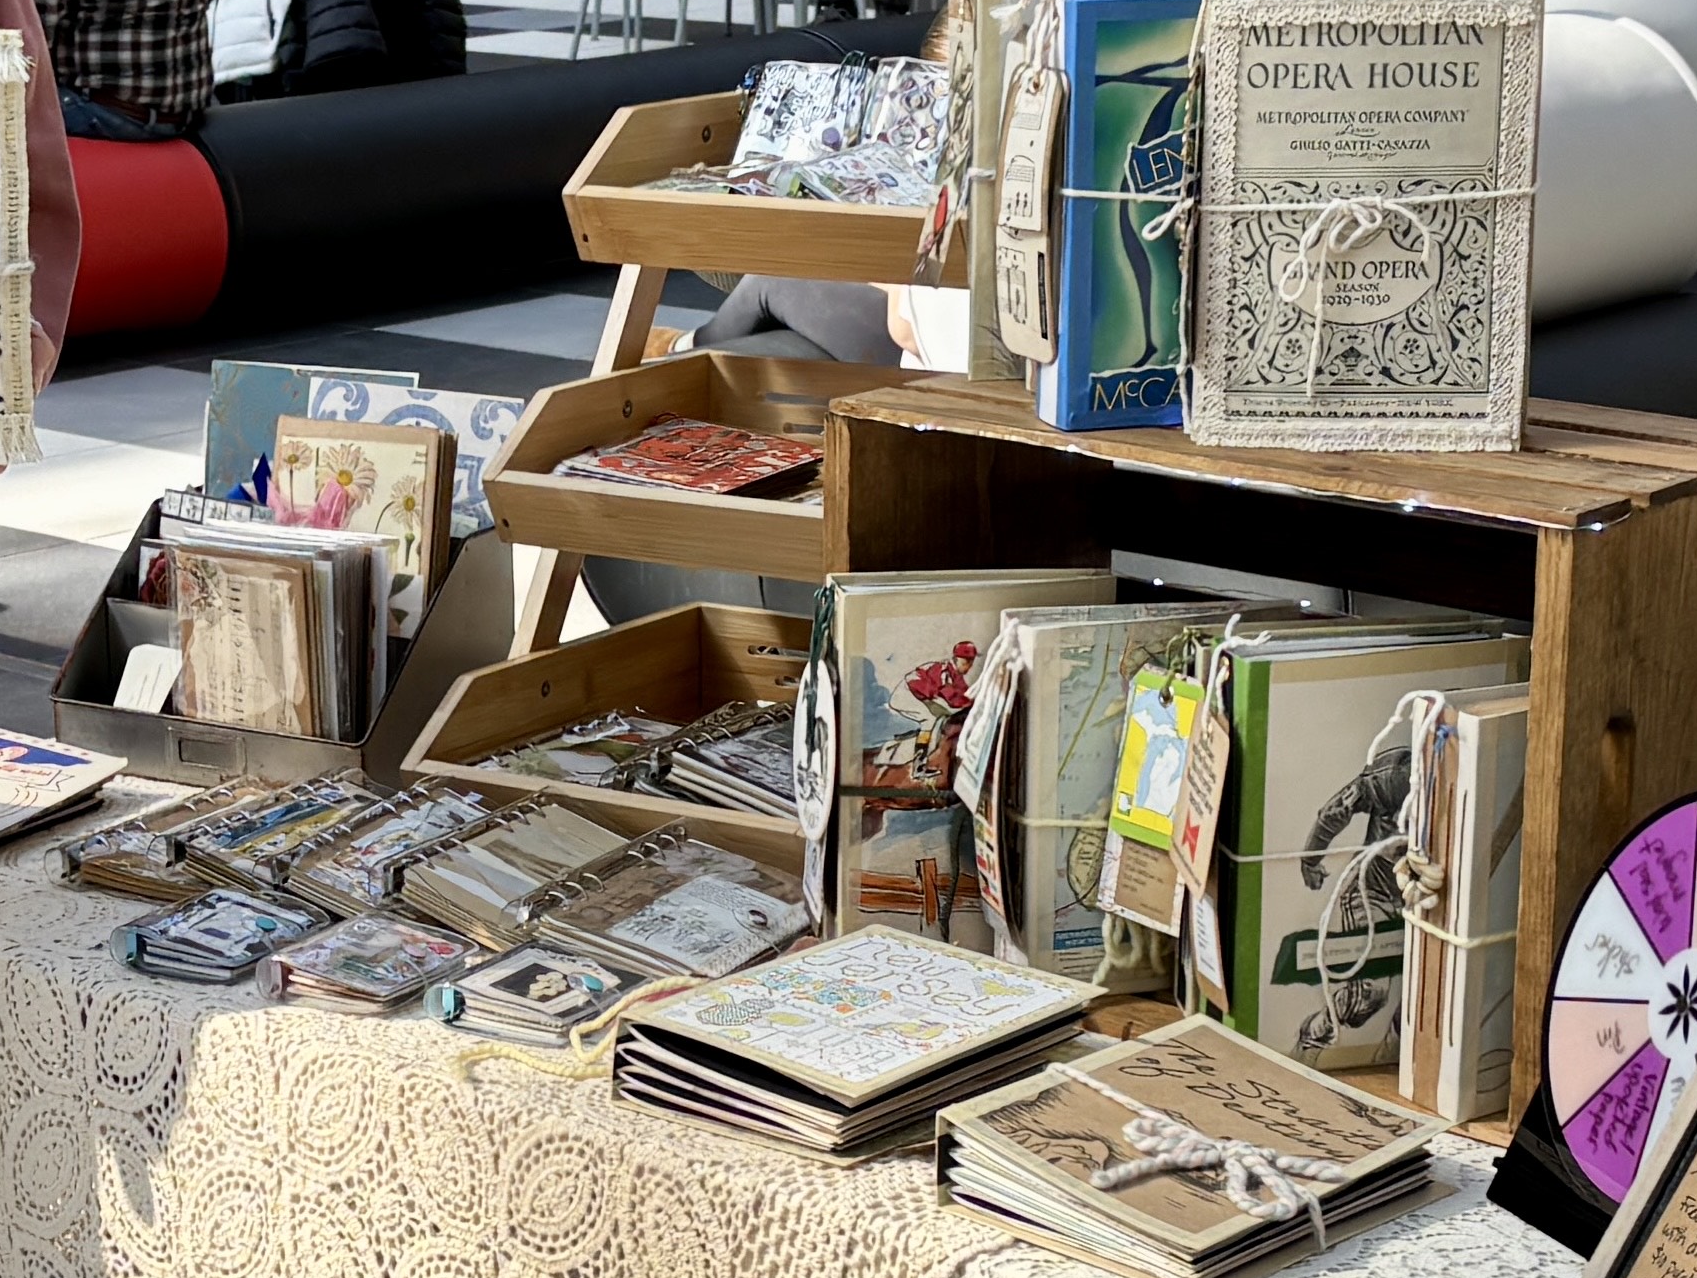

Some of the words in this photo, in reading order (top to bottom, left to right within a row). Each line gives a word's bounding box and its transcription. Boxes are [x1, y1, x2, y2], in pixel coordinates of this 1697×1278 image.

[1245, 22, 1485, 48] METROPOLITAN
[1247, 62, 1355, 91] OPERA
[1367, 61, 1481, 89] HOUSE
[1256, 110, 1356, 126] METROPOLITAN
[1358, 110, 1402, 125] OPERA
[1404, 109, 1470, 124] COMPANY
[1362, 260, 1430, 280] OPERA
[1335, 282, 1381, 293] SEASON
[1322, 293, 1391, 307] 1929-1930
[1118, 1056, 1198, 1079] of
[1153, 1038, 1217, 1076] The
